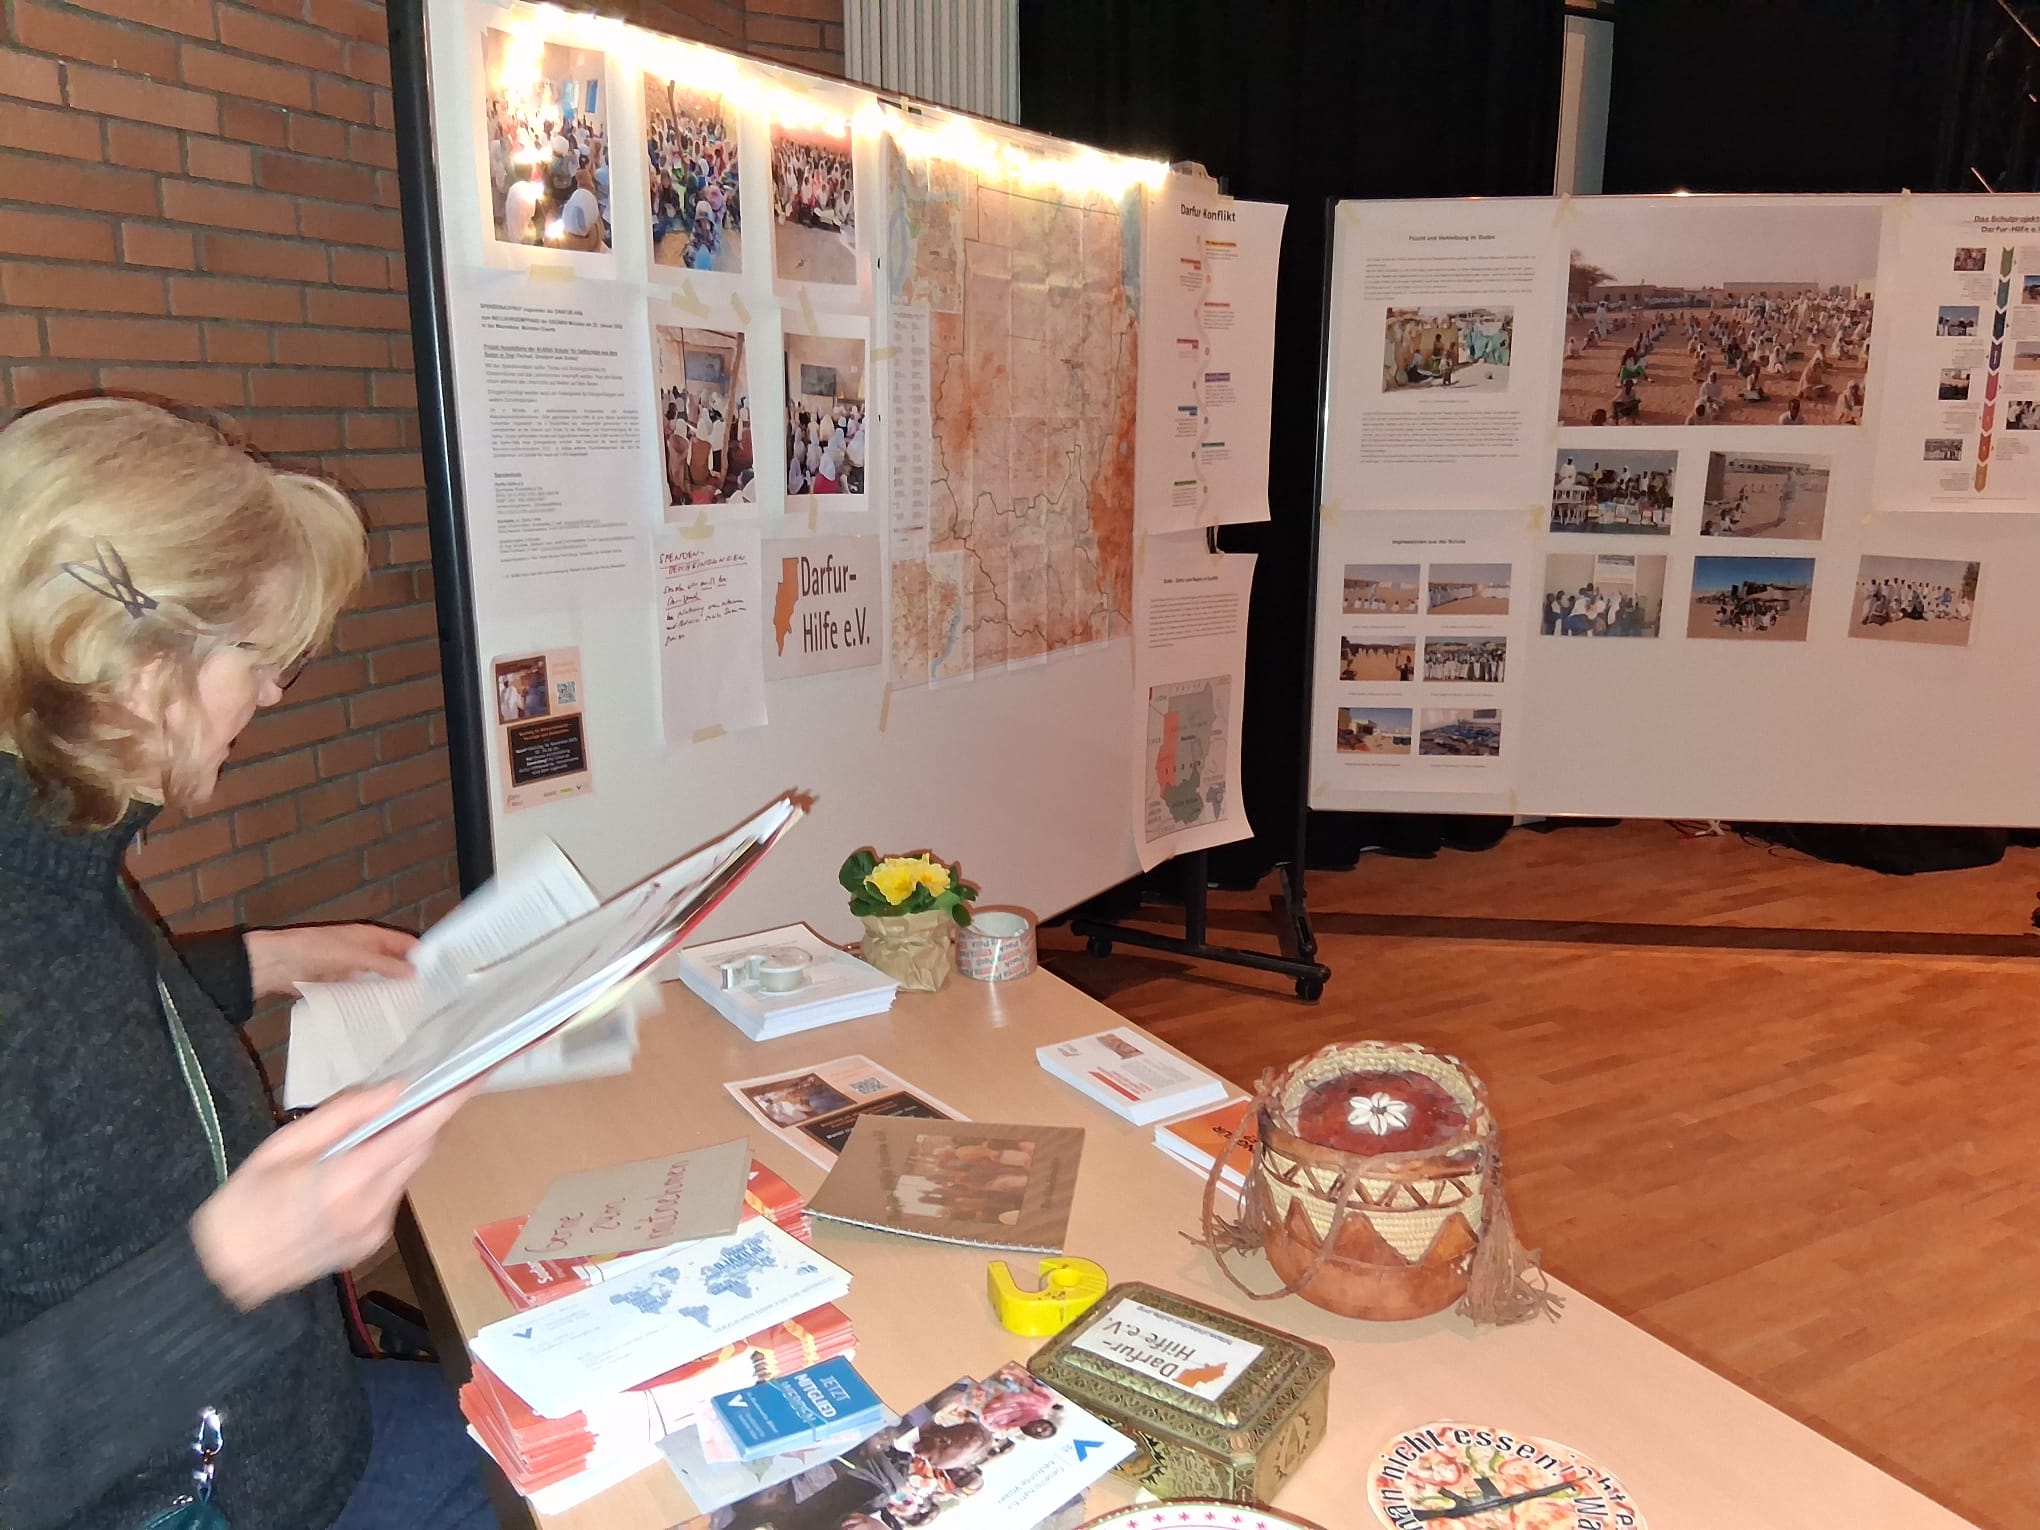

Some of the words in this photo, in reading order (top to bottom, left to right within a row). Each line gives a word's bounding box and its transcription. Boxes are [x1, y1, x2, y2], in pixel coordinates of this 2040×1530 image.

[1180, 204, 1201, 217] Darfur
[1203, 209, 1236, 222] Konflikt
[801, 554, 857, 597] Darfur-
[803, 611, 838, 653] Hilfe
[844, 607, 870, 648] e.V.
[1102, 1317, 1141, 1337] e.V.
[1103, 1340, 1179, 1378] Darfur-
[1145, 1332, 1196, 1361] Hilfe
[794, 1373, 837, 1418] MITGLIED
[820, 1375, 851, 1401] JETZT
[1381, 1429, 1445, 1480] nicht
[1454, 1429, 1574, 1476] essen!
